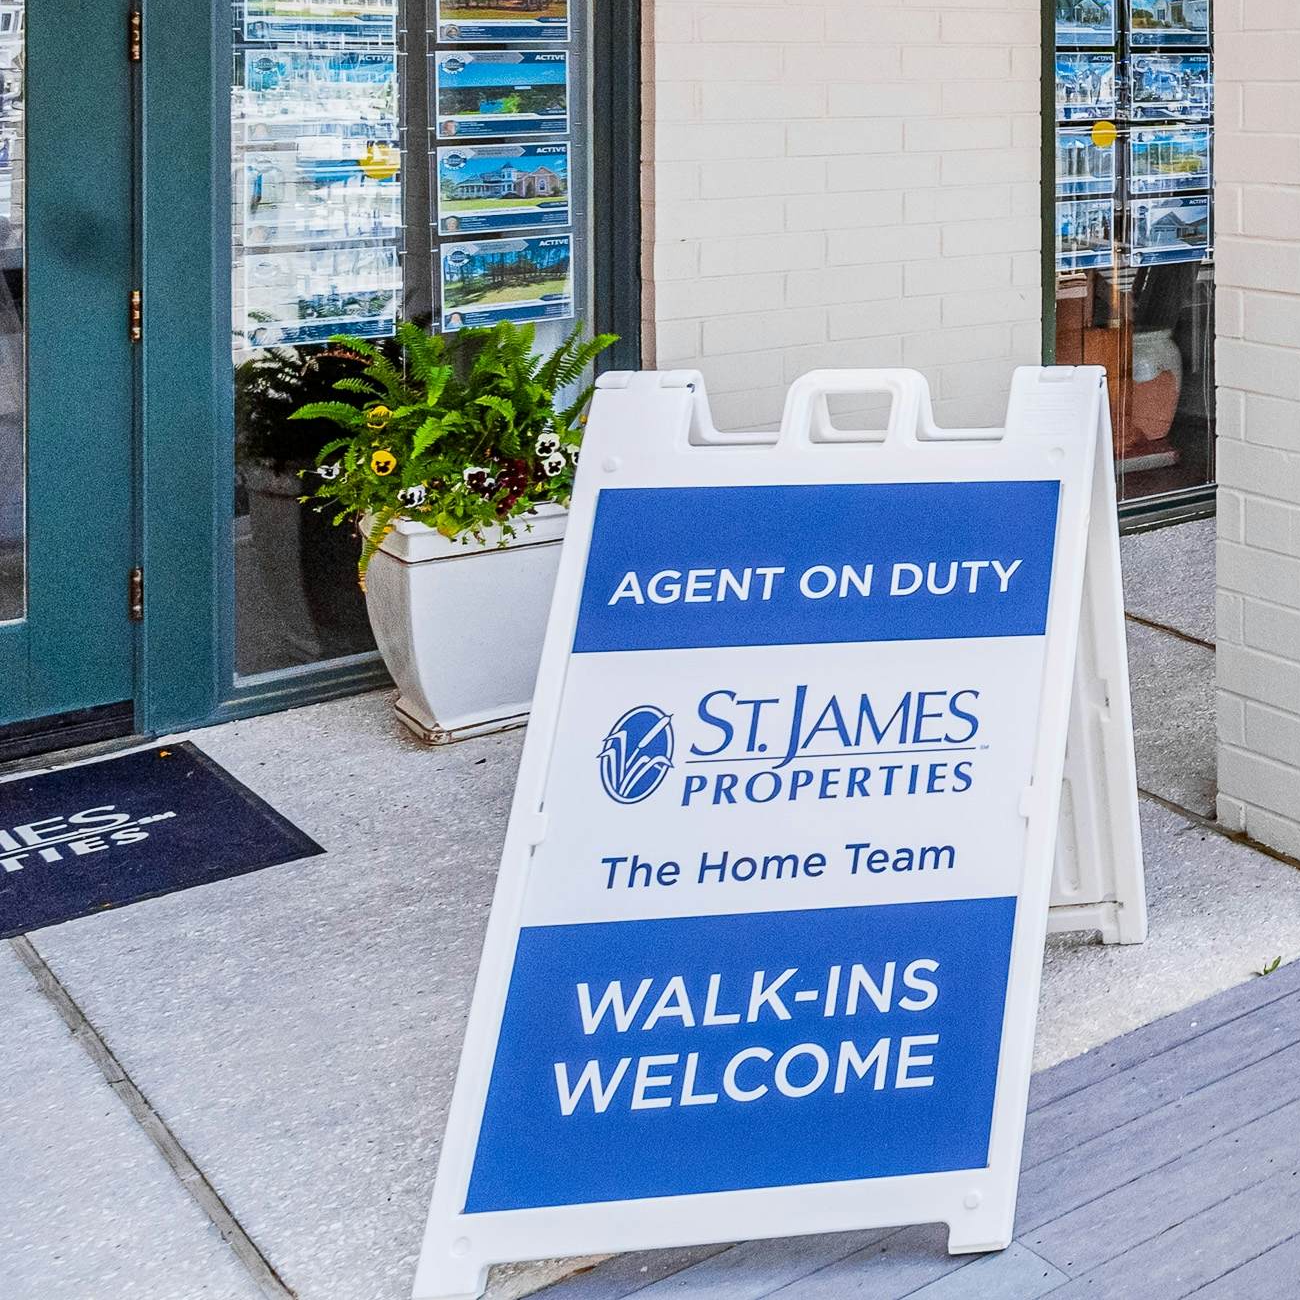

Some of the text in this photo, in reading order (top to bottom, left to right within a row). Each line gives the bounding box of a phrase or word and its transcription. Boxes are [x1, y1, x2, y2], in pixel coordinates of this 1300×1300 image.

[607, 559, 1023, 606] AGENT ON DUTY
[680, 761, 974, 808] PROPERTIES
[601, 842, 956, 890] The Home Team
[575, 957, 940, 1037] WALK-INS
[552, 1033, 940, 1117] WELCOME
